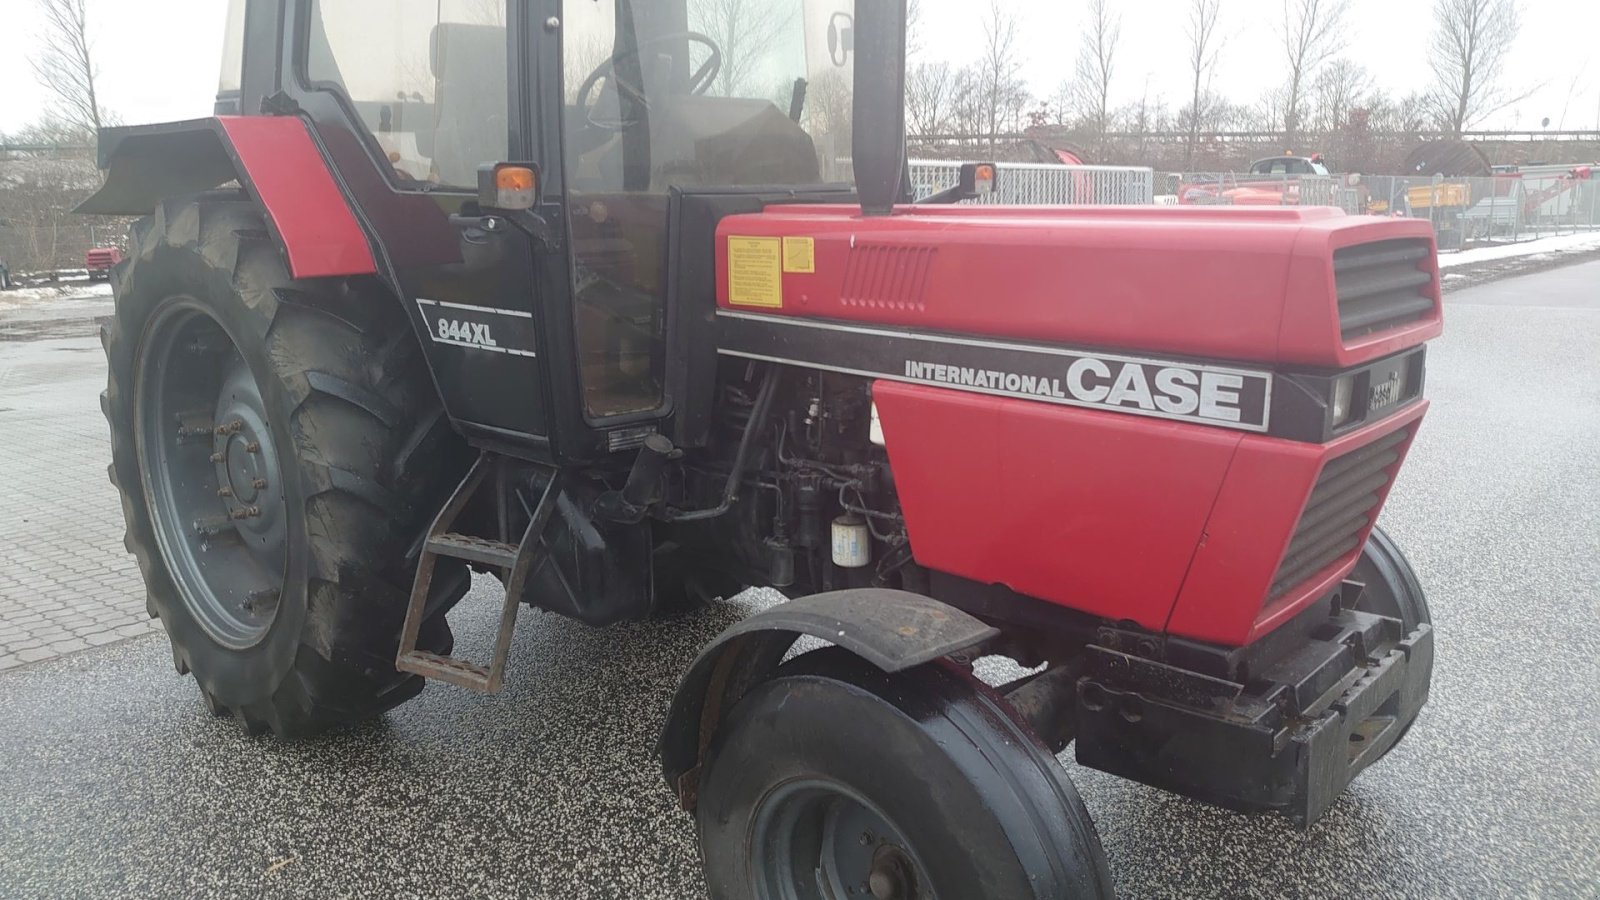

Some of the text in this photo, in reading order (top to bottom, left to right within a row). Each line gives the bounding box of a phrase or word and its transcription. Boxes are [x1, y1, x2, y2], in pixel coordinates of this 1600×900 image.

[438, 319, 497, 346] 844XL
[904, 358, 1243, 421] INTERNATIONAL CASE
